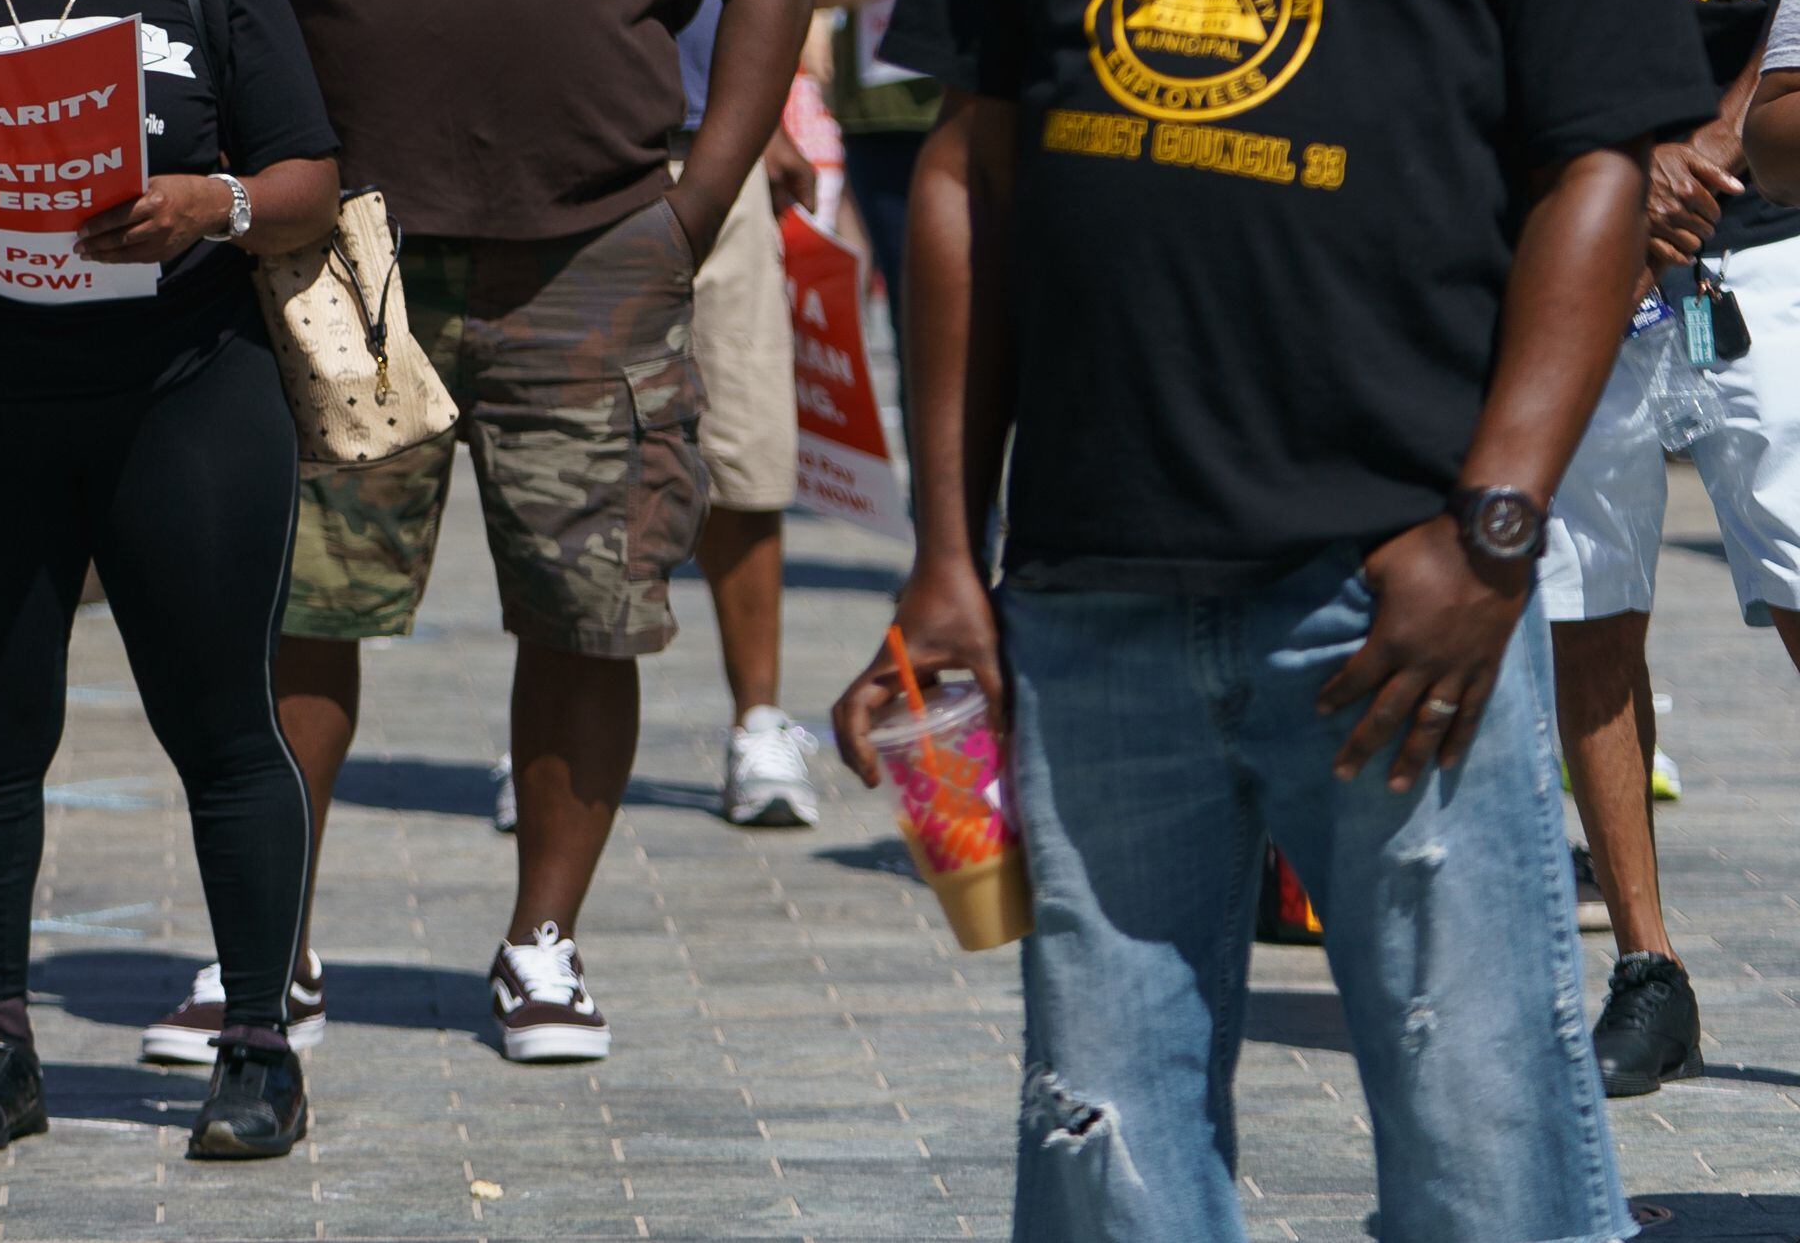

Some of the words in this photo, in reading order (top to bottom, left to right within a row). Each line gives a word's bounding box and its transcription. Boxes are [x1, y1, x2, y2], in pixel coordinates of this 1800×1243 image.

[1133, 29, 1243, 63] MUNICIPAL
[1104, 47, 1269, 109] EMPLOYEES
[145, 113, 165, 135] rike
[1151, 122, 1297, 186] COUNCIL
[1300, 140, 1348, 192] 33
[6, 246, 70, 269] Pay
